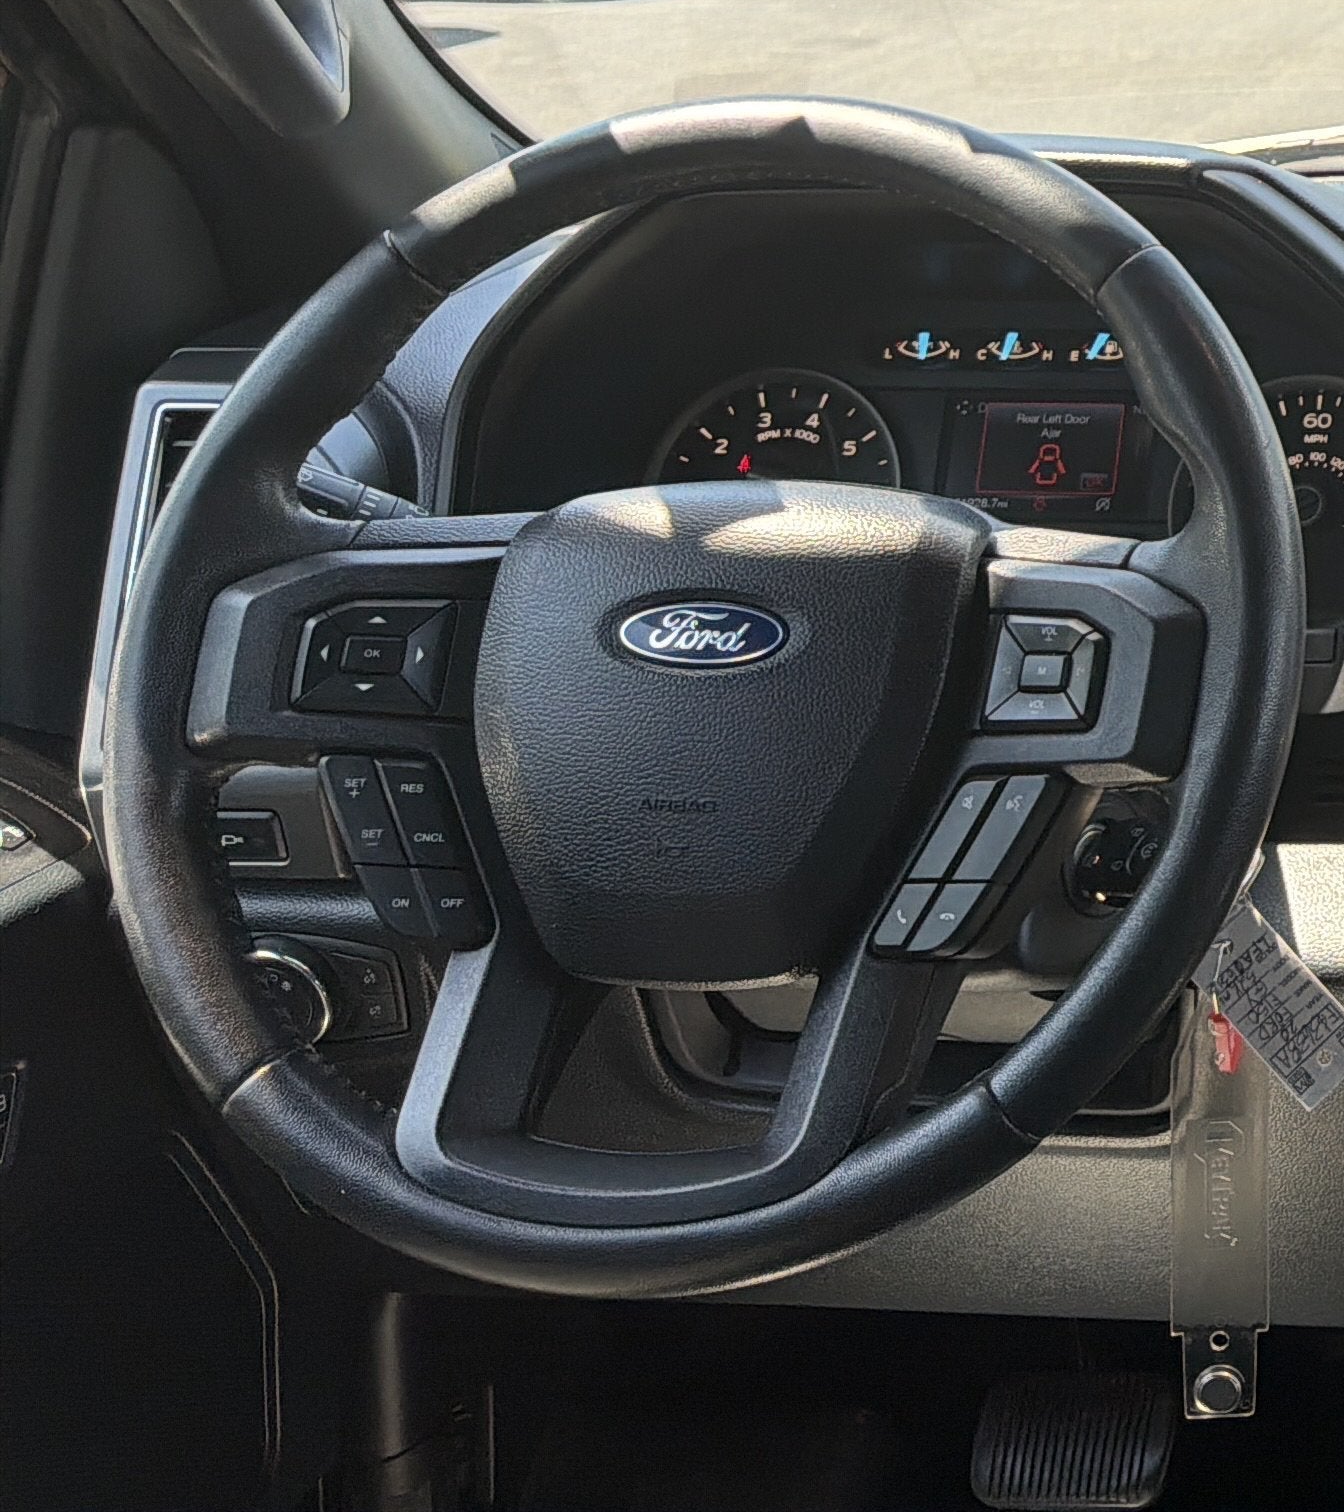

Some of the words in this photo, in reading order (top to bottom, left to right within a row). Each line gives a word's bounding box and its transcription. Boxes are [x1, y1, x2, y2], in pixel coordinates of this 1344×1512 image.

[883, 348, 893, 360] L
[949, 348, 961, 360] H
[976, 349, 988, 361] C
[1042, 349, 1053, 361] H
[1069, 350, 1080, 362] E
[757, 412, 772, 428] 3
[804, 413, 820, 428] 4
[1016, 413, 1040, 424] Rear
[1042, 413, 1062, 424] Left
[1064, 413, 1090, 424] Door
[1302, 412, 1333, 429] 60
[756, 429, 782, 443] RPM
[784, 429, 793, 438] X
[795, 429, 820, 444] 1000
[1040, 427, 1062, 439] Ajar
[1303, 433, 1329, 444] MPH
[713, 438, 729, 455] 2
[841, 440, 857, 456] 5
[1309, 451, 1327, 463] 100
[648, 609, 747, 653] Ford
[1041, 626, 1059, 637] VOL
[362, 648, 381, 660] OK
[1028, 699, 1046, 710] VOL
[343, 777, 368, 789] SET
[399, 782, 425, 795] RES
[360, 828, 384, 841] SET
[413, 832, 446, 844] CNCL
[391, 898, 410, 910] ON
[440, 897, 465, 910] OFF
